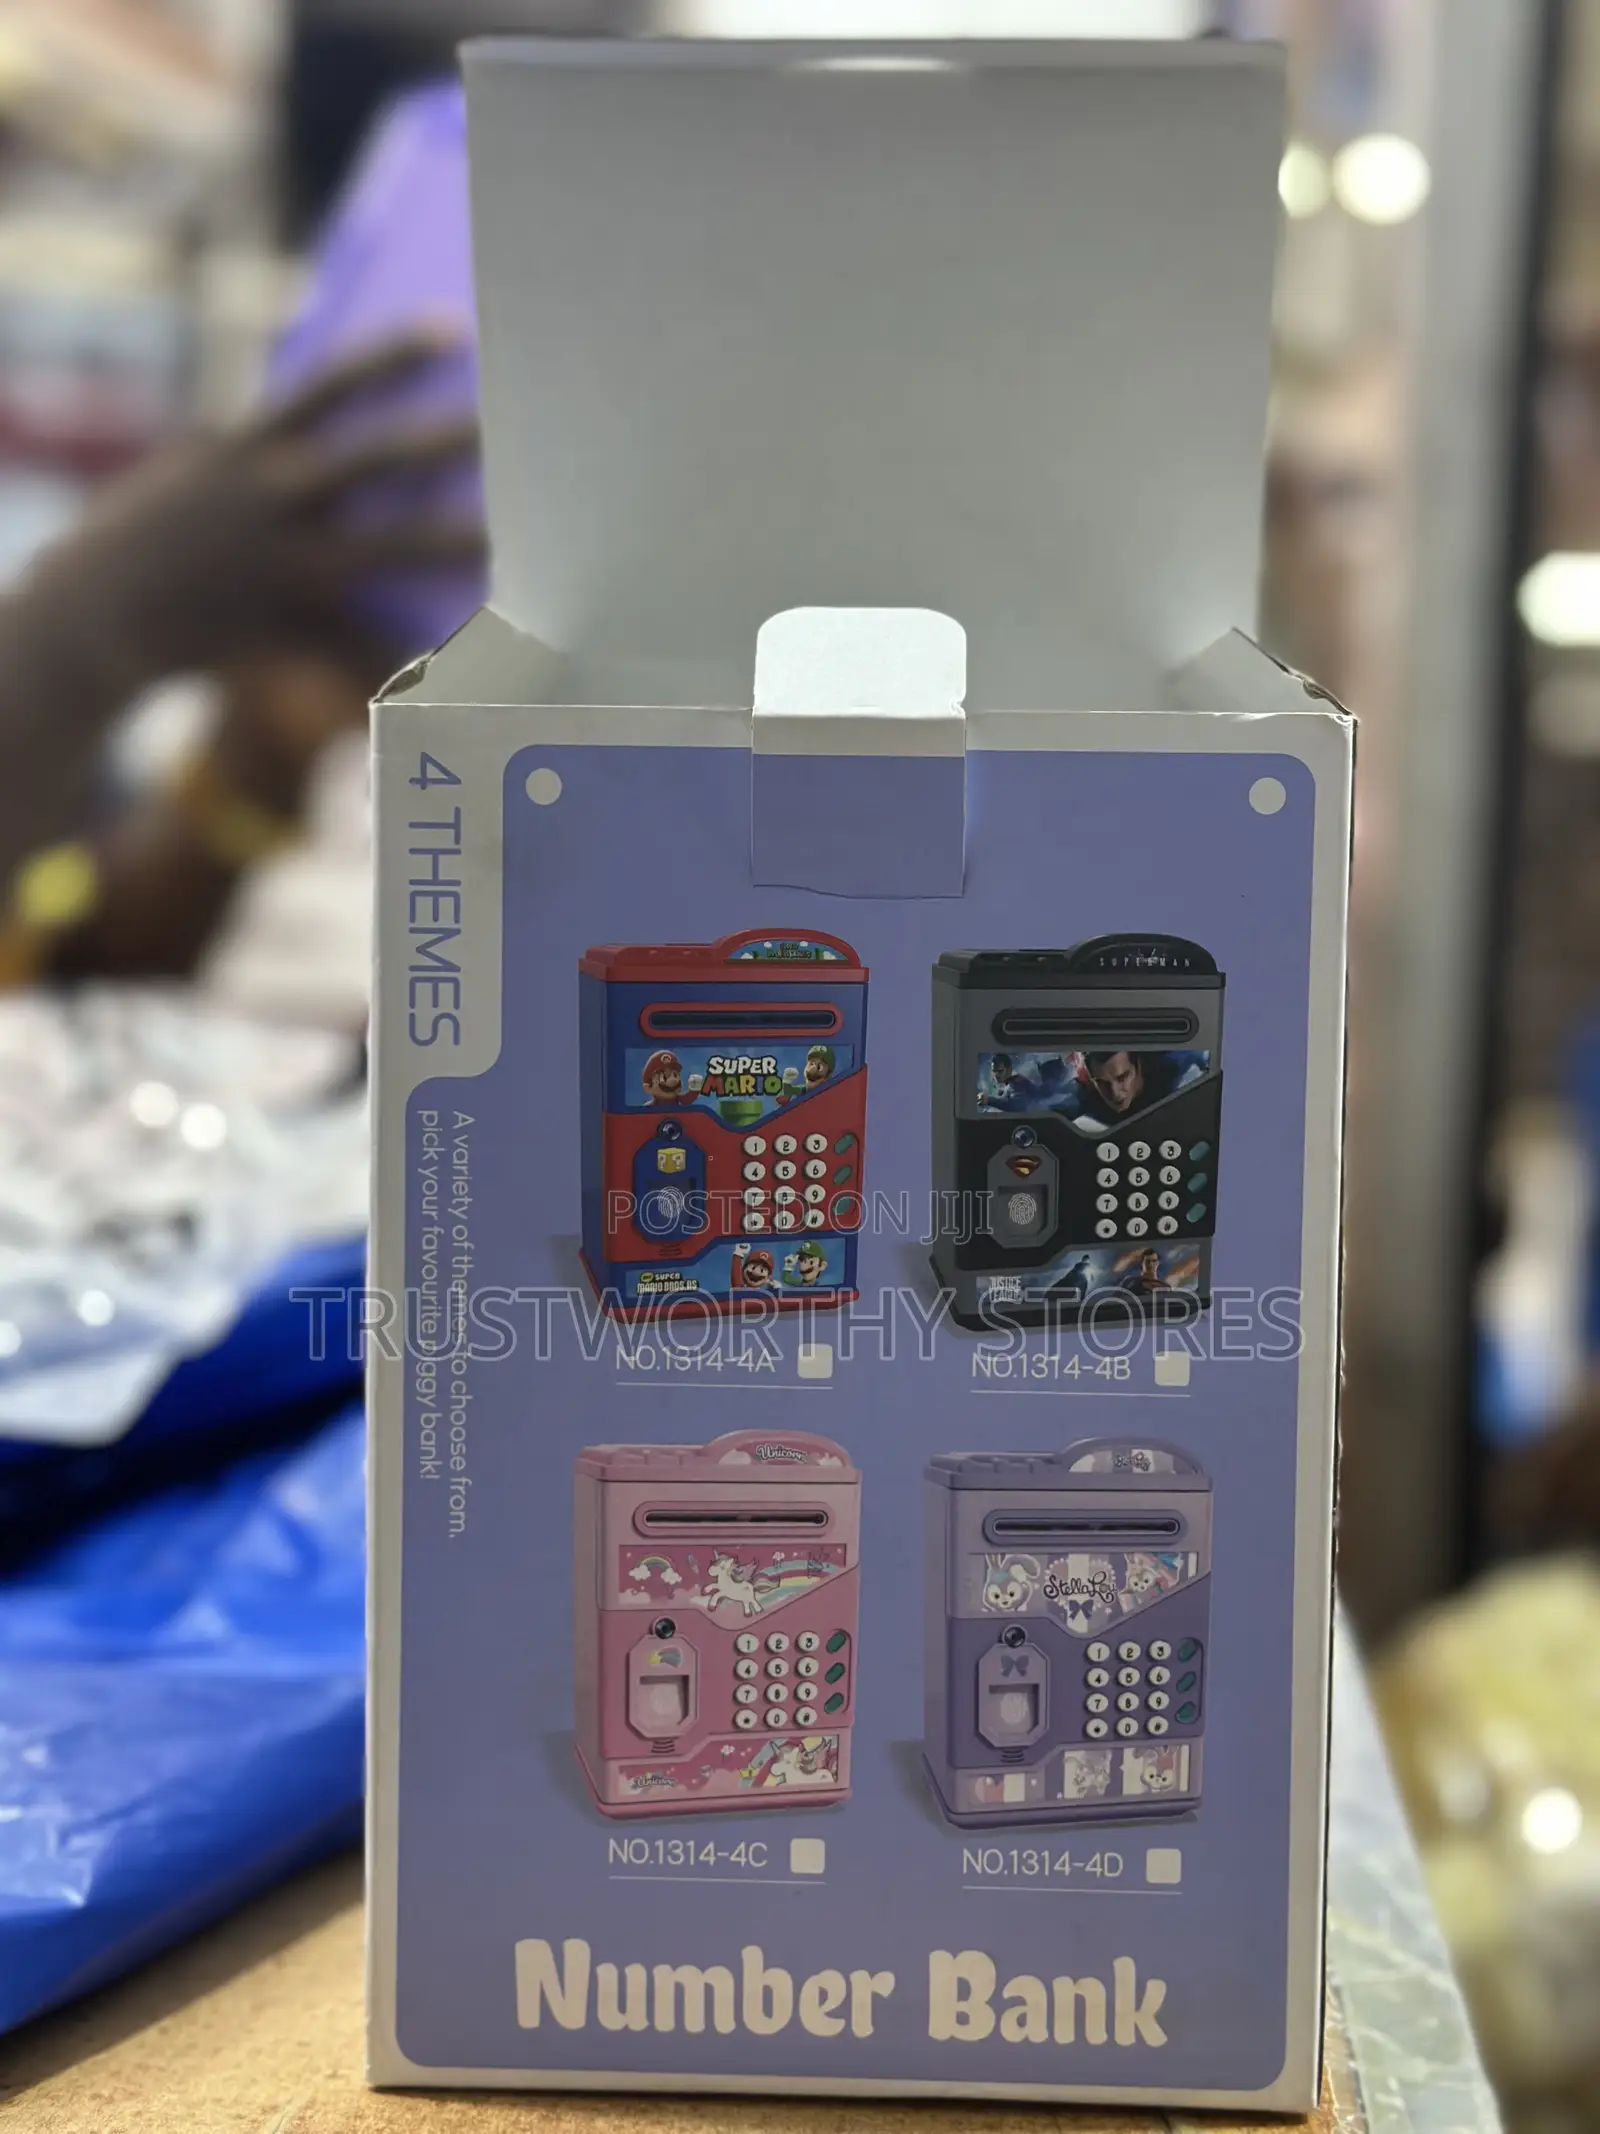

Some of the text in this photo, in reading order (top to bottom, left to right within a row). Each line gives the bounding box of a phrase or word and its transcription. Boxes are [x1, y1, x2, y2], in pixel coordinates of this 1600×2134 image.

[408, 751, 462, 1046] 4 THEMES
[708, 1055, 777, 1075] SUPER
[700, 1074, 783, 1097] MARIO
[453, 1110, 476, 1130] A
[448, 1134, 473, 1220] variety
[451, 1225, 475, 1252] of
[415, 1110, 447, 1480] pick your favourite piggy bank!
[450, 1256, 475, 1345] themes
[451, 1349, 468, 1375] to
[616, 1345, 776, 1372] NO.1314-4A
[972, 1352, 1131, 1380] NO.1314-4B
[449, 1380, 474, 1472] choose
[756, 1444, 808, 1464] Unicorn
[608, 1838, 768, 1867] NO.1314-4C
[962, 1848, 1123, 1877] NO.1314-4D
[514, 1938, 1168, 2047] Number Bank
